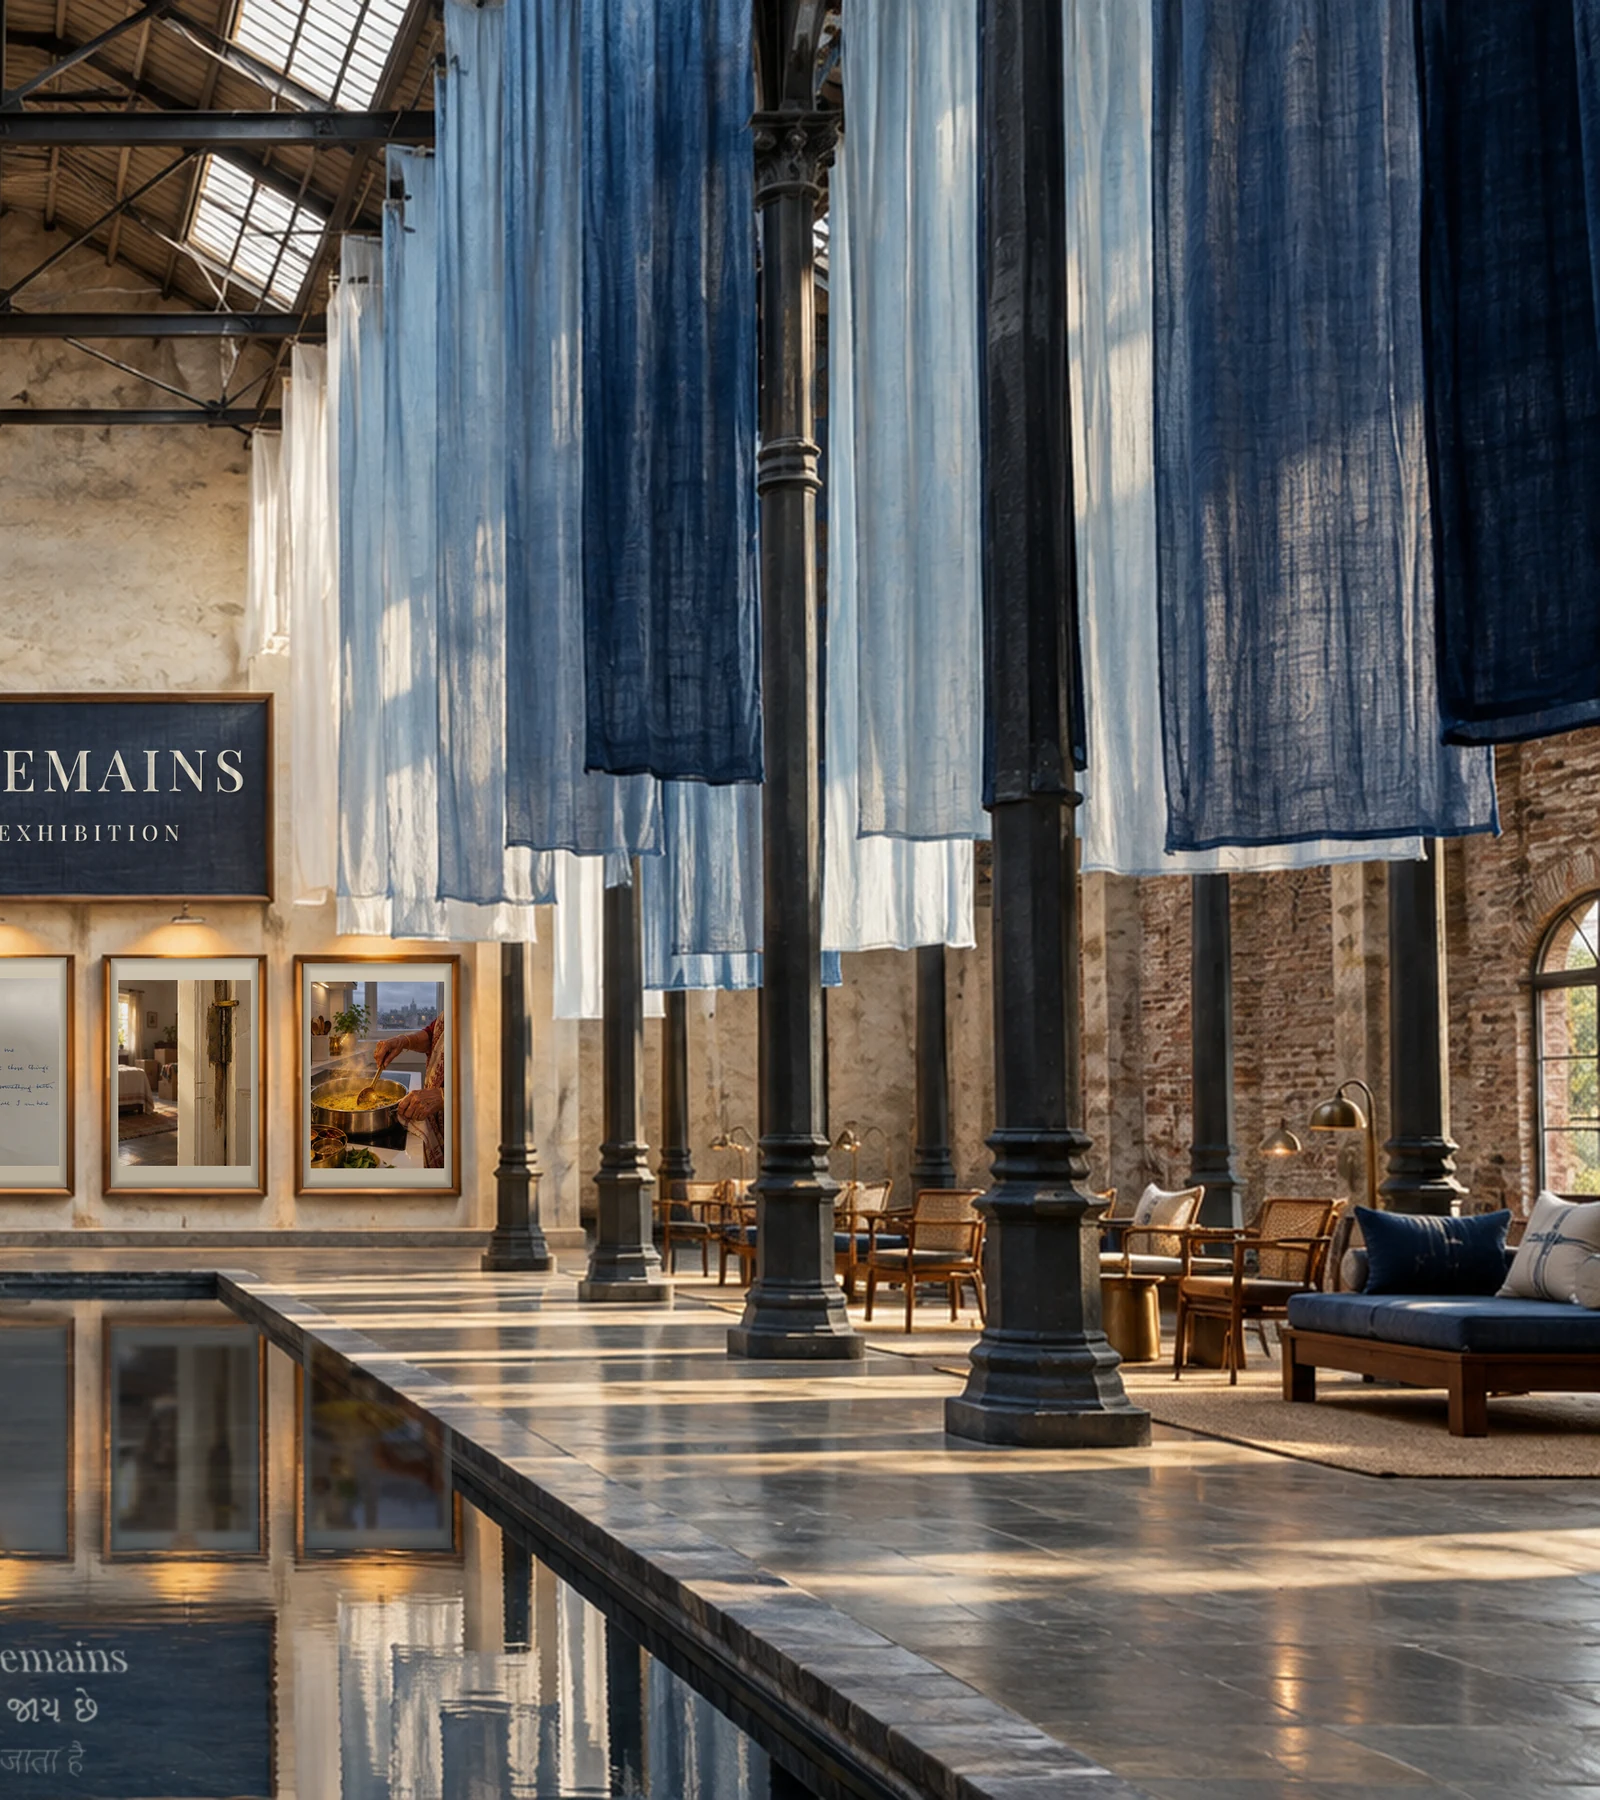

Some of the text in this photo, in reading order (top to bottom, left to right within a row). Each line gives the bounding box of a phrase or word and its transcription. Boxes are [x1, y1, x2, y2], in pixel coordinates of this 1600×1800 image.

[6, 1697, 61, 1723] જાય
[73, 1687, 99, 1723] છે
[0, 1748, 63, 1775] जाता
[67, 1740, 87, 1778] है
